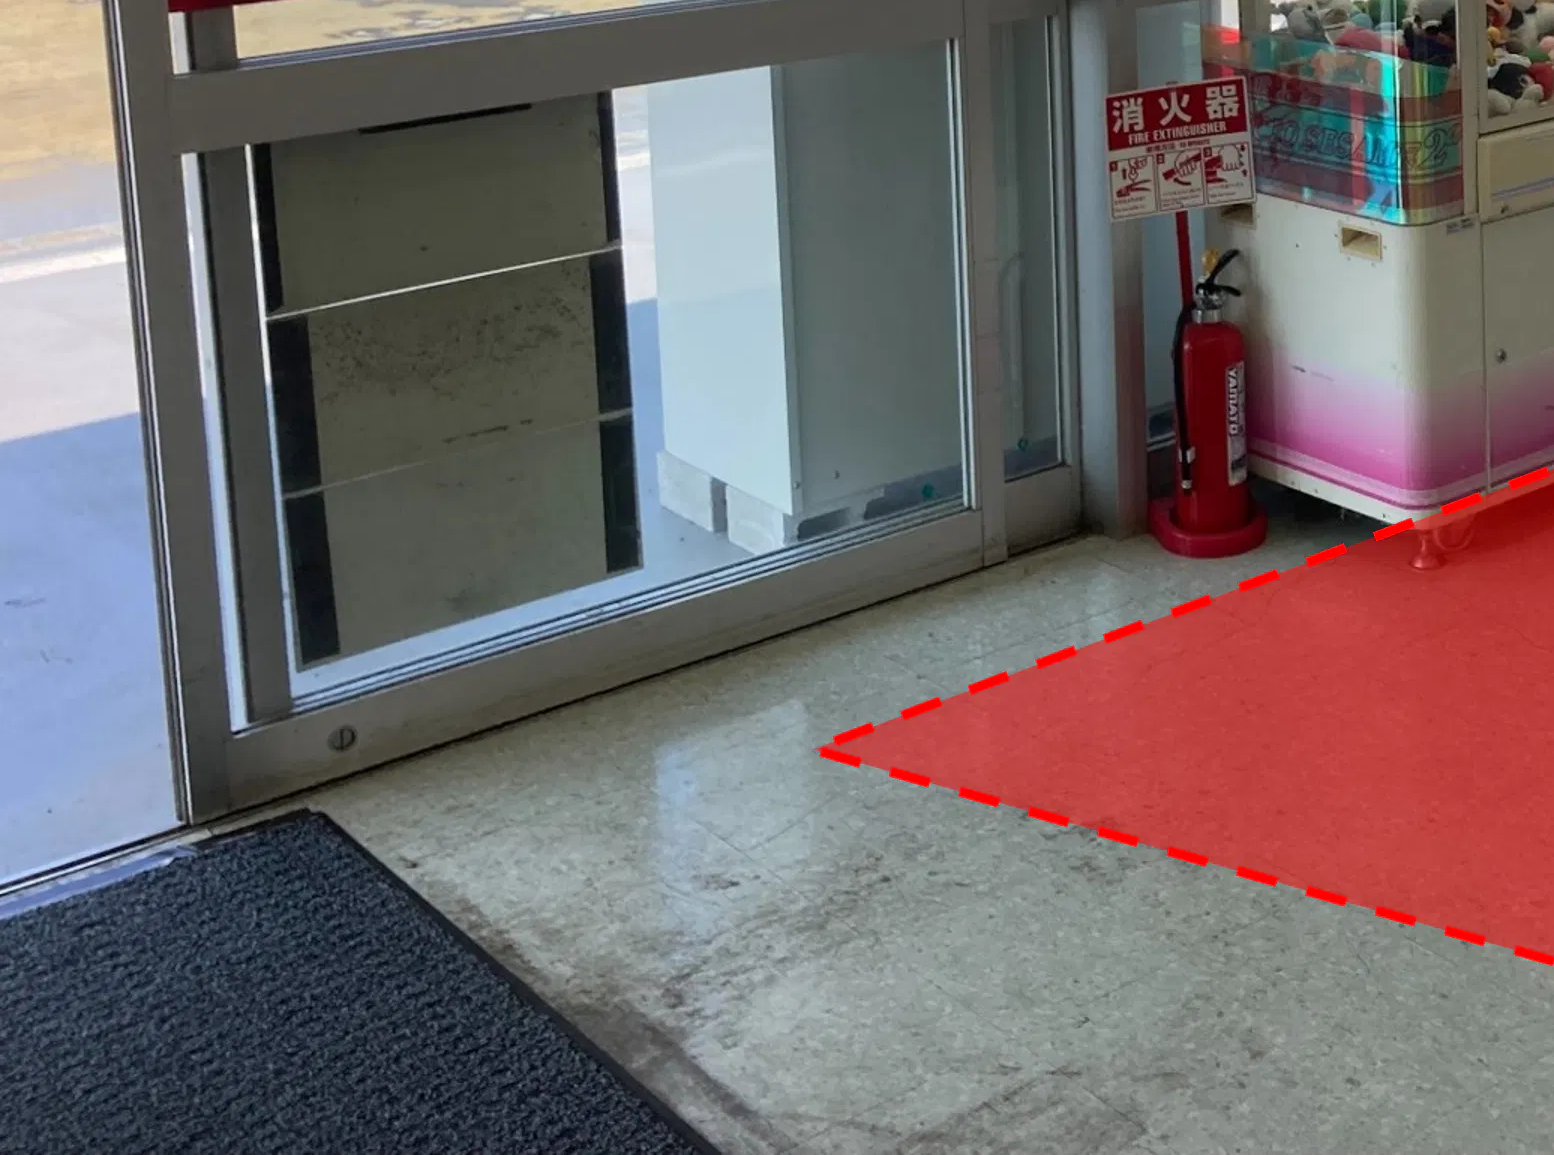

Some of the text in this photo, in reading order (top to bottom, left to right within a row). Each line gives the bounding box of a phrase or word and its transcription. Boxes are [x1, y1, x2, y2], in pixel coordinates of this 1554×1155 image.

[1112, 83, 1240, 134] 消火器
[1128, 121, 1228, 146] FIRE EXTINGUISHER
[1227, 366, 1239, 436] YAMATO
